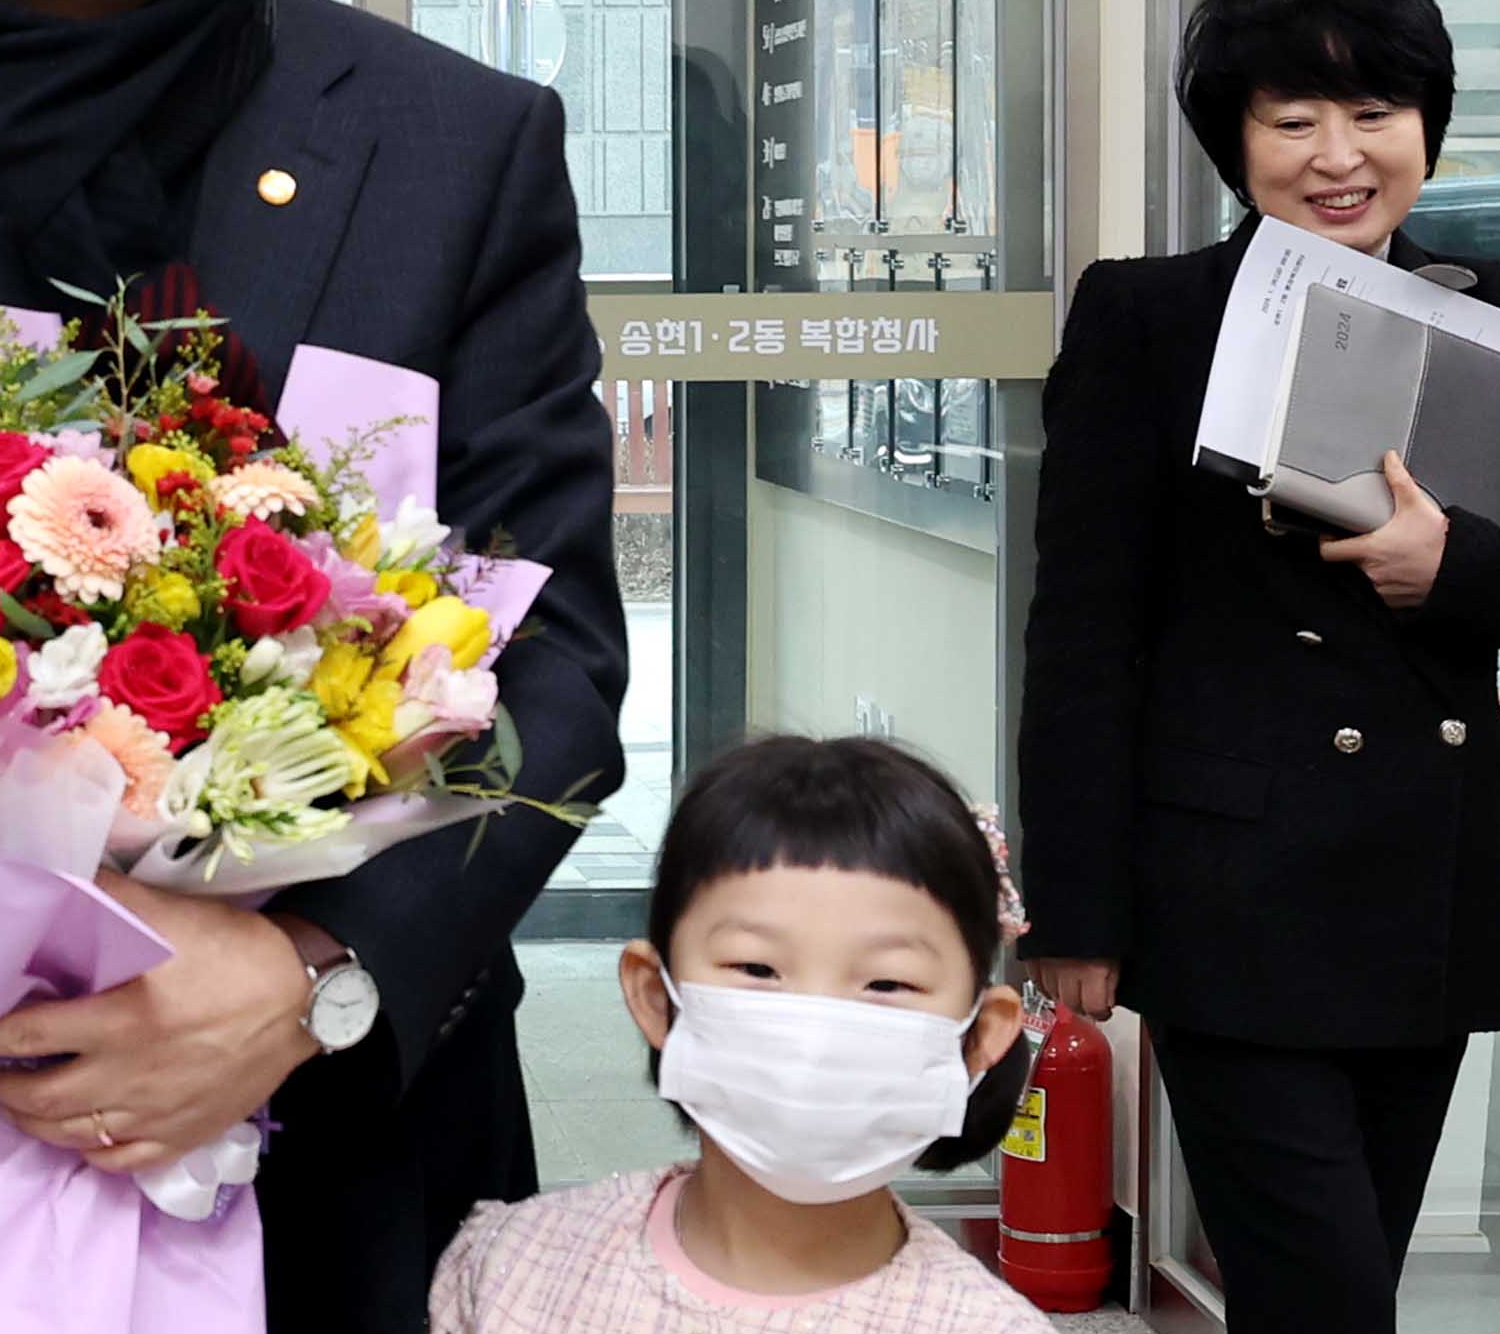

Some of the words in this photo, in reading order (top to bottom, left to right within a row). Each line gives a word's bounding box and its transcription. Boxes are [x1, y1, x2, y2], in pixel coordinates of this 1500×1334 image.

[620, 318, 786, 356] 송현1·2동
[800, 317, 939, 355] 복합청사
[1335, 312, 1352, 351] 2024
